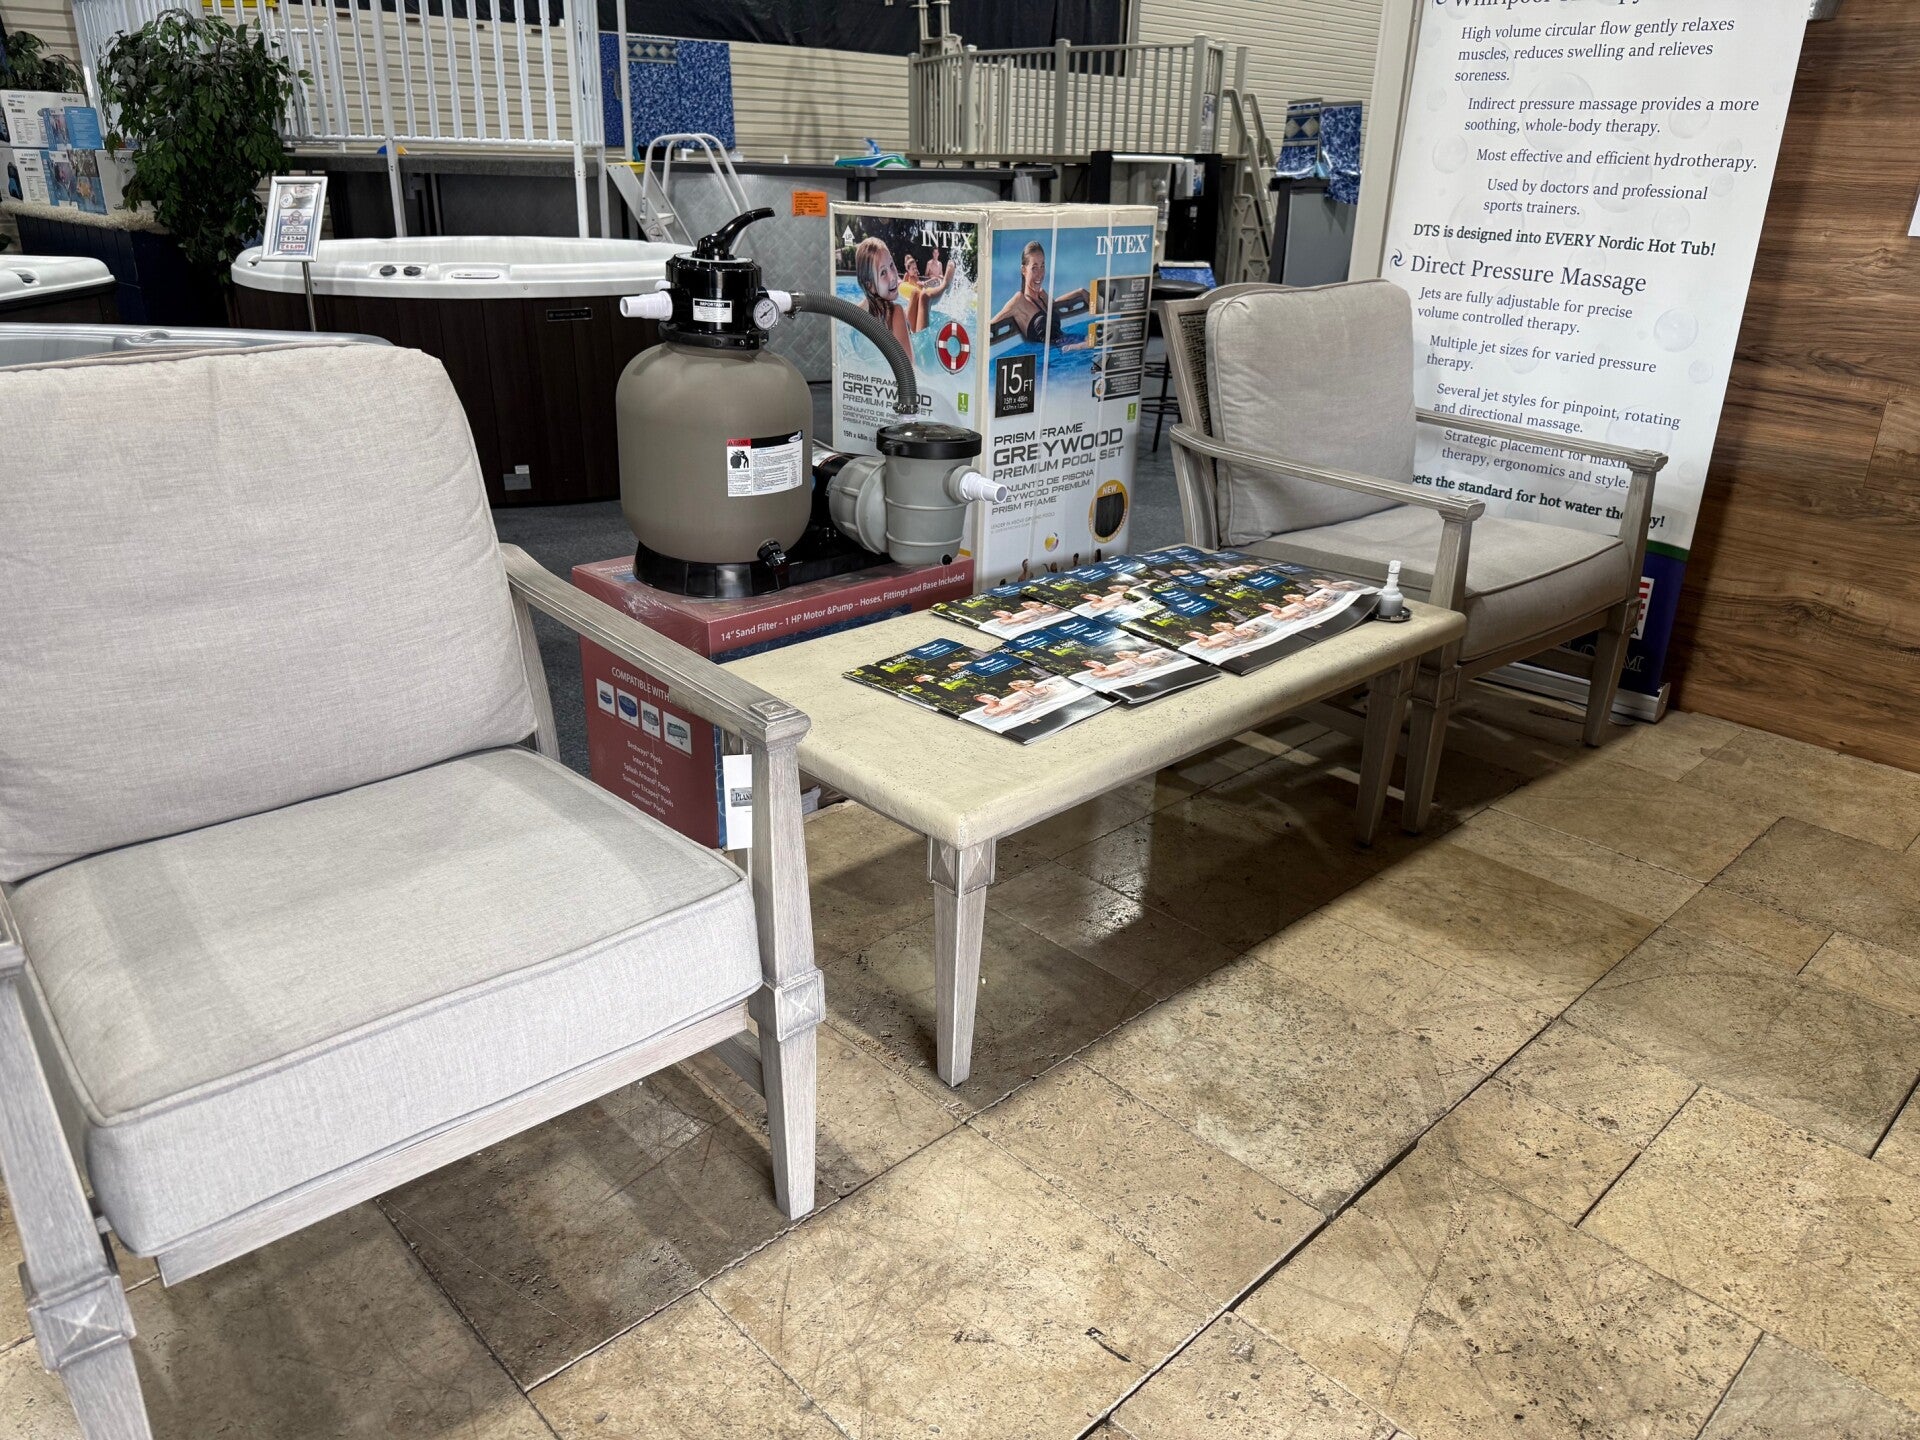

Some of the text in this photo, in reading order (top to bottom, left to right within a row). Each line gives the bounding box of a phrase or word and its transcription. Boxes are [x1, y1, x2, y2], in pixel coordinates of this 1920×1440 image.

[1461, 17, 1735, 42] High volume circular flow gently relaxes
[1458, 42, 1714, 62] muscles, reduces swelling and relieves
[1454, 71, 1510, 82] soreness.
[1468, 97, 1759, 114] Indirect pressure massage provides a more
[1464, 118, 1661, 136] soothing, whole-body therapy.
[1476, 148, 1757, 172] Most effective and efficient hydrotherapy.
[1488, 178, 1708, 200] Used by doctors and professional
[1484, 200, 1580, 215] sports trainers.
[921, 230, 974, 250] INTEX
[1096, 234, 1148, 256] INTEX
[1414, 224, 1716, 256] DTS is designed into EVERY Nordic Hot Tub!
[1410, 255, 1647, 296] Direct Pressure Massage
[1418, 286, 1633, 318] Jets are fully adjustable for precise
[1418, 306, 1580, 336] volume controlled therapy.
[1427, 353, 1474, 372] therapy.
[1430, 334, 1657, 373] Multiple jet sizes for varied pressure
[842, 372, 868, 382] PRISM
[1002, 364, 1033, 394] 15 FT
[842, 393, 884, 408] PREMIUM
[1436, 382, 1681, 430] Several jet styles for pinpoint, rotating
[1434, 402, 1584, 434] and directional massage.
[994, 422, 1083, 446] PRISM FRAME
[1444, 429, 1498, 448] Strategic
[1500, 440, 1564, 458] placement
[994, 428, 1123, 466] GREYWOOD
[993, 446, 1124, 481] PREMIUM POOL SET
[1442, 447, 1629, 488] therapy, ergonomics and style.
[1047, 476, 1059, 485] DE
[1062, 469, 1094, 480] PISCINA
[1052, 479, 1090, 493] PREMIUM
[1103, 484, 1117, 496] NEW
[1436, 476, 1455, 489] the
[1458, 481, 1512, 500] standard
[1515, 490, 1536, 503] for
[1539, 493, 1562, 508] hot
[1565, 500, 1602, 516] water
[992, 496, 1057, 515] PRISM FRAME
[736, 626, 756, 638] Sand
[757, 622, 777, 634] Filter
[785, 617, 789, 626] 1
[791, 614, 802, 624] HP
[803, 608, 826, 622] Motor
[827, 602, 853, 616] &Pump
[860, 595, 882, 606] Hoses,
[884, 588, 908, 600] Fittings
[909, 584, 921, 594] and
[923, 581, 937, 590] Base
[938, 573, 965, 586] Included
[612, 667, 652, 694] COMPATIBLE
